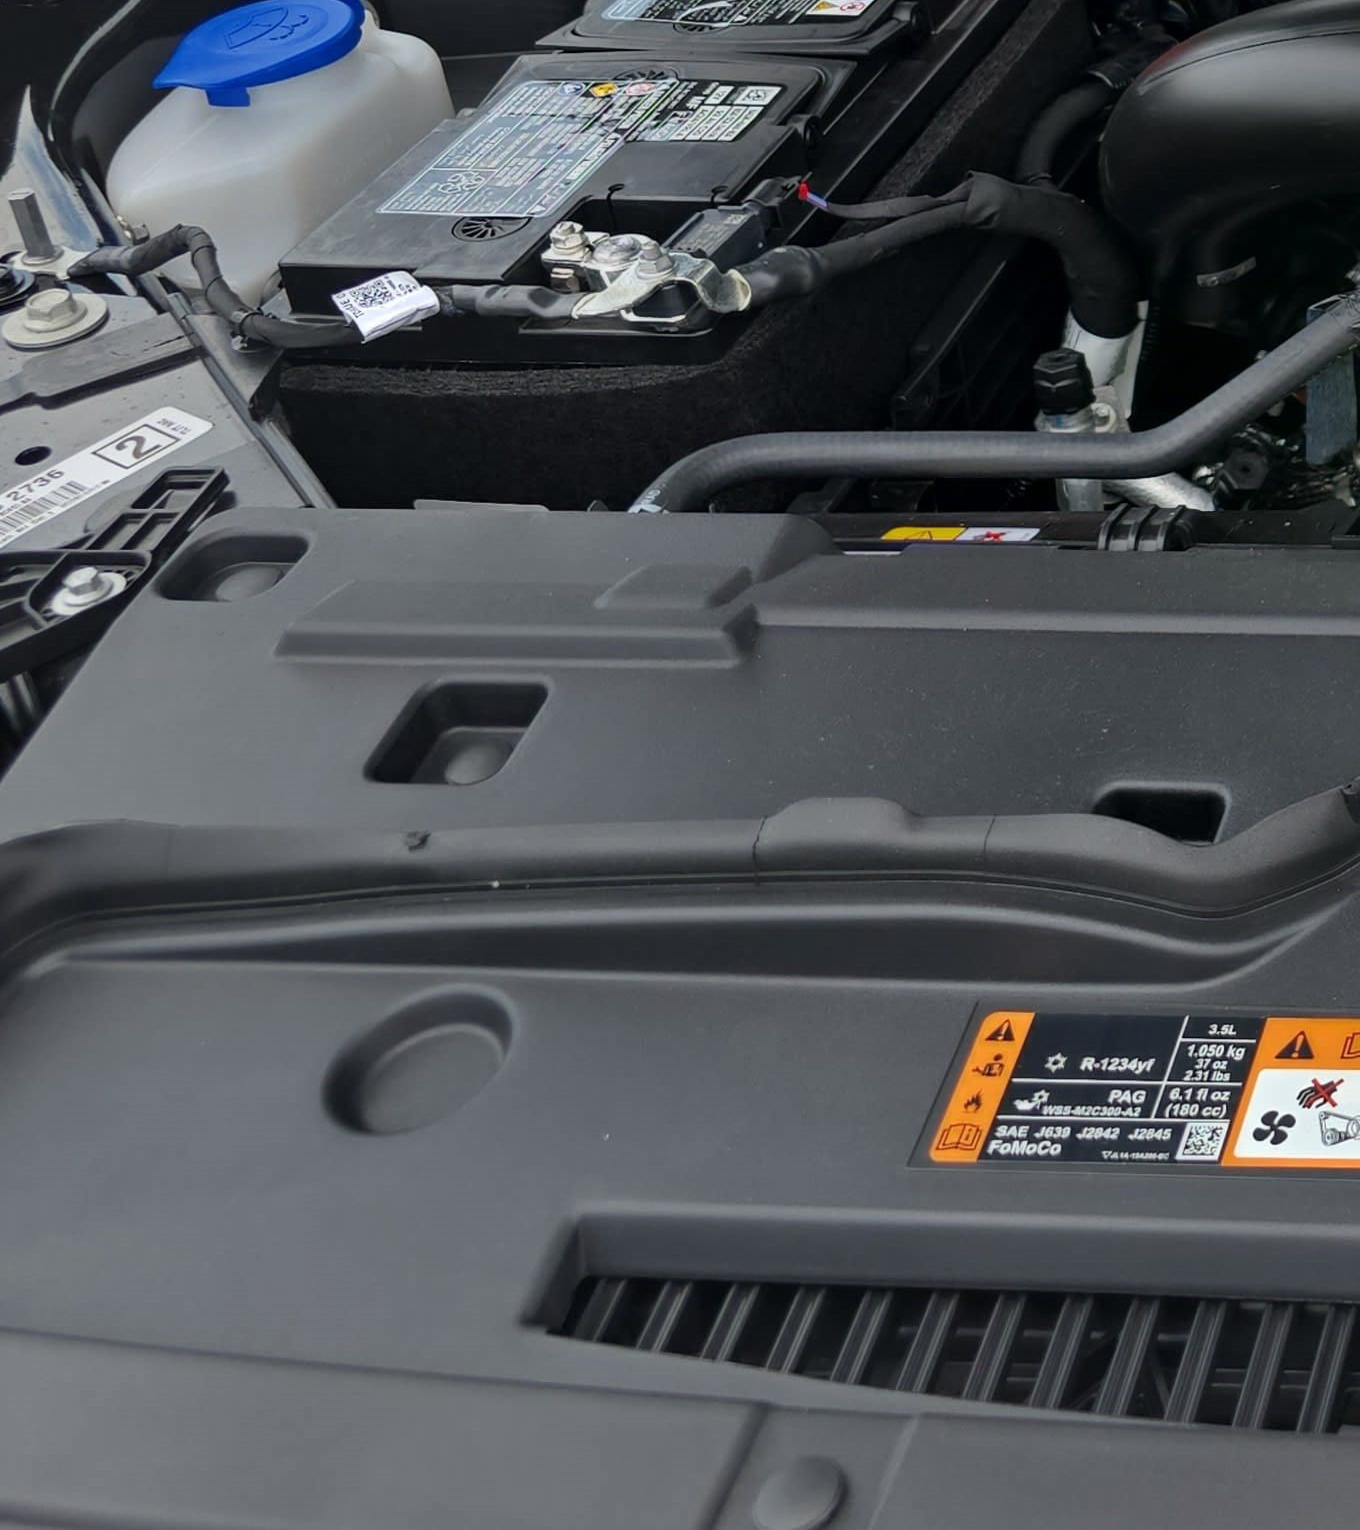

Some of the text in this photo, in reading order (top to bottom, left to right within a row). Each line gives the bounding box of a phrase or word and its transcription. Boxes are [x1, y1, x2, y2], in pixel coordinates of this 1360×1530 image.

[114, 435, 165, 460] 2
[6, 469, 65, 502] 2736
[1208, 1024, 1237, 1036] 3.5L
[1187, 1044, 1246, 1061] 1.050 kg
[1080, 1057, 1156, 1073] R-1234yf
[1194, 1058, 1229, 1070] 37 oz
[1183, 1070, 1231, 1082] 2.31 lbs
[1108, 1089, 1147, 1104] PAG
[1169, 1087, 1231, 1102] 6.1 fl oz
[1165, 1102, 1227, 1118] (180 cc)
[994, 1125, 1173, 1141] SAE J639 J2842 J2845
[986, 1140, 1063, 1157] FoMoCo
